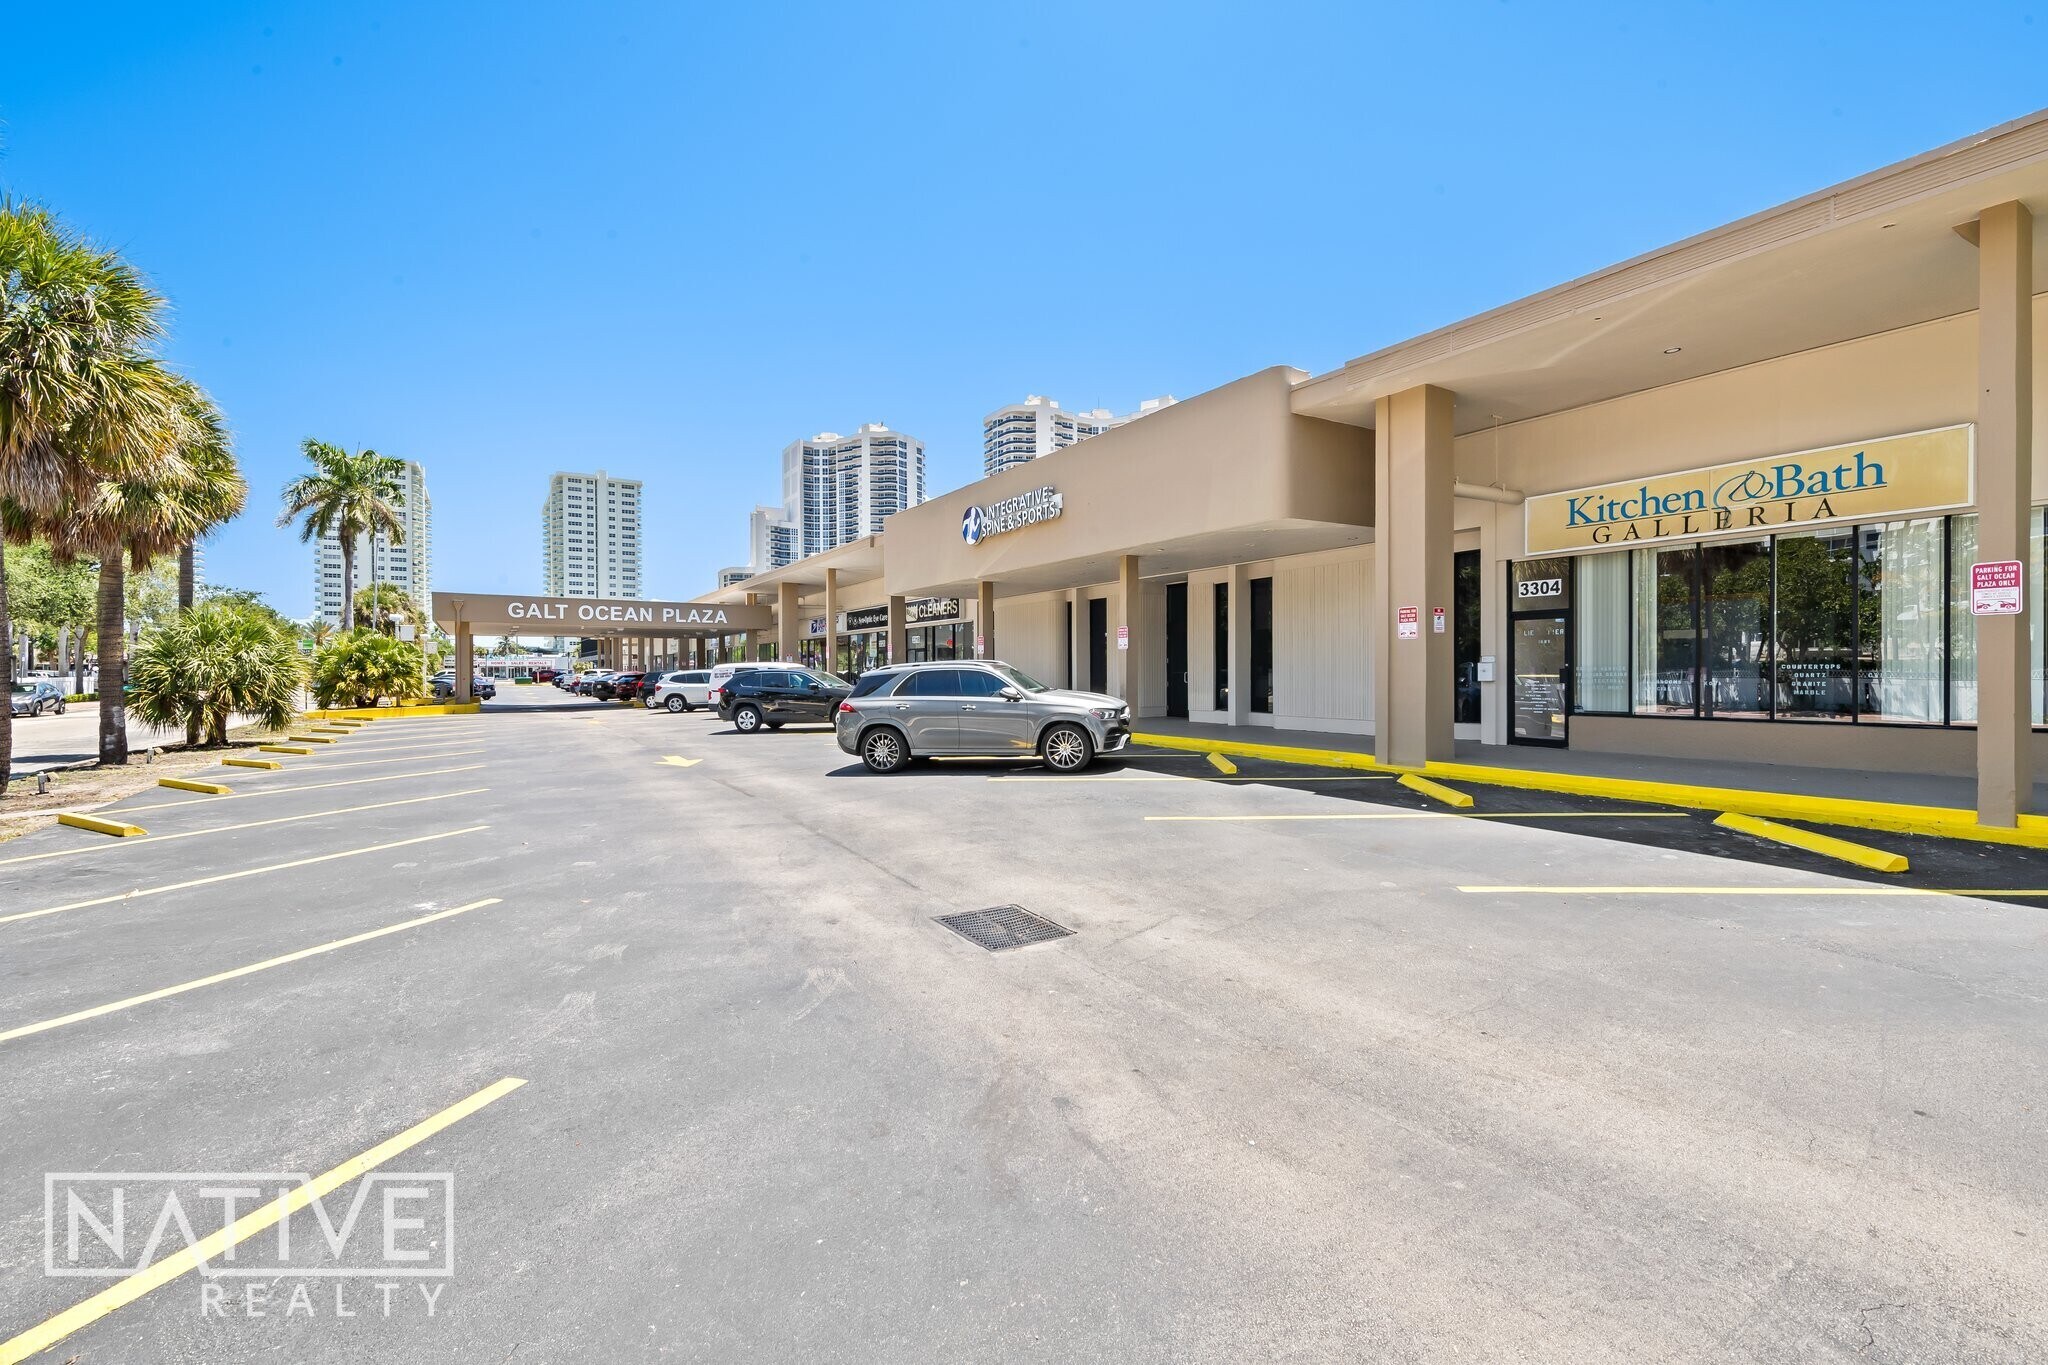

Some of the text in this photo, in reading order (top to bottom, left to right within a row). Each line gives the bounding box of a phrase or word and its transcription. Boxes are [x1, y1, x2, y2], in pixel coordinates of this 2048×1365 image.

[1565, 486, 1708, 526] Kitchen
[1770, 451, 1888, 499] Bath
[986, 486, 1049, 518] INTEGRATIVE
[981, 501, 1056, 537] SPINE & SPORTS
[1592, 497, 1838, 544] GALLERIA
[1975, 566, 2003, 574] PARKING
[1994, 572, 2016, 580] OCEAN
[1520, 580, 1560, 596] 3304
[1977, 579, 2016, 588] PLAZA ONLY
[507, 602, 728, 625] GALT OCEAN PLAZA
[918, 600, 958, 618] CLEANERS
